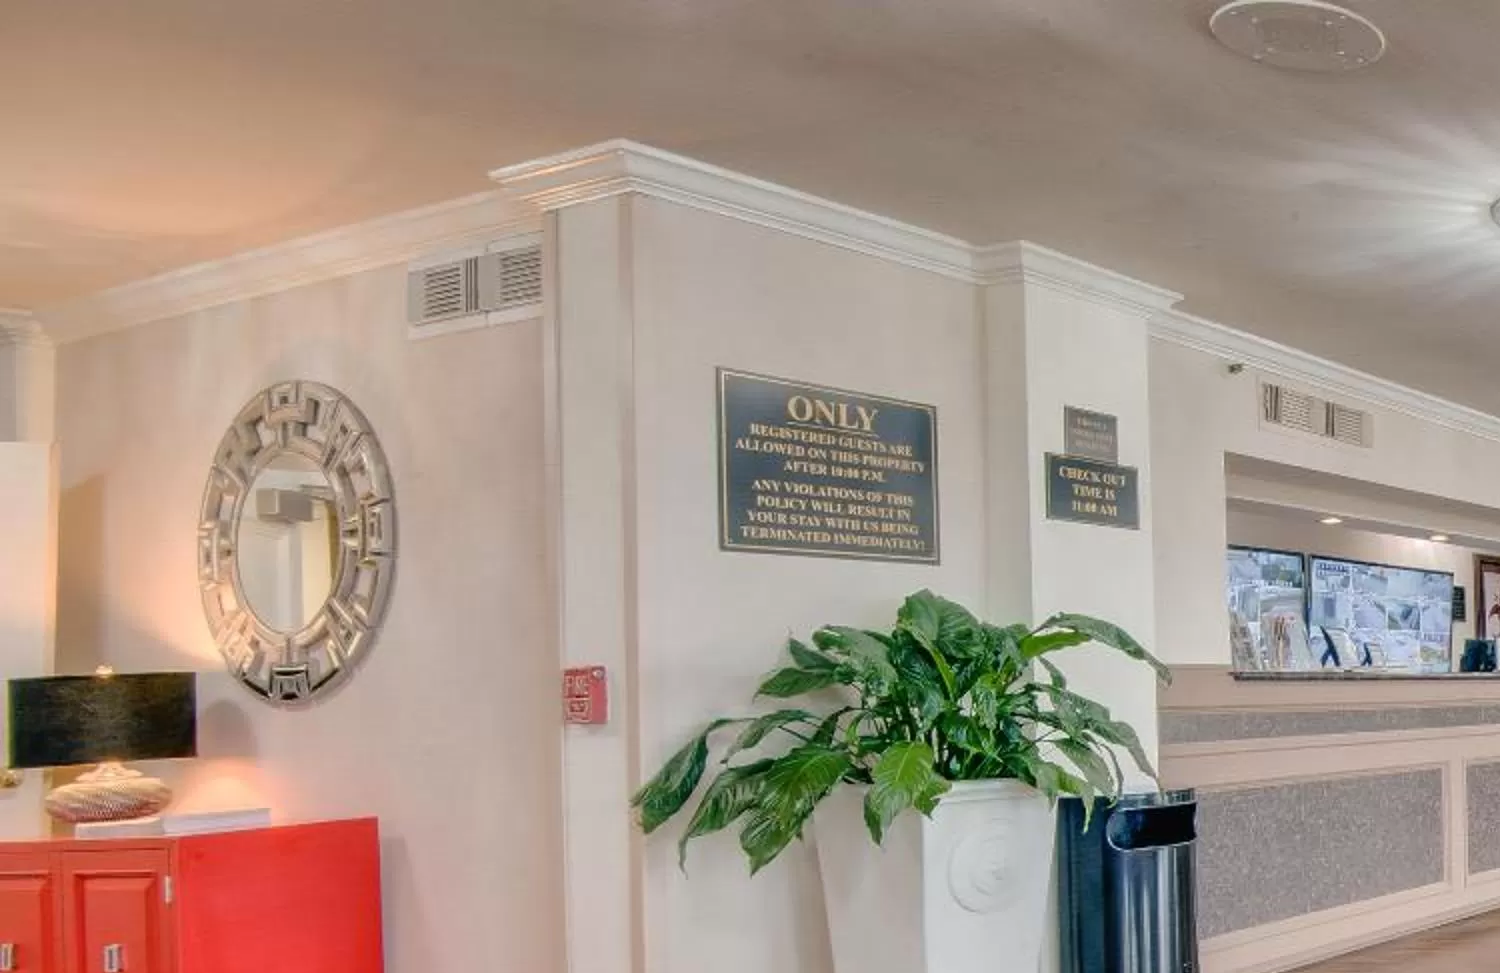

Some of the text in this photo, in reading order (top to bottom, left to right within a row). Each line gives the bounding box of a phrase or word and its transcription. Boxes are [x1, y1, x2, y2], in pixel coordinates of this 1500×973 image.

[787, 395, 880, 431] ONLY
[749, 422, 913, 458] REGISTERED GUESTS ARE
[735, 437, 925, 473] ALLOWED ON THIS PROPERTY
[783, 460, 828, 475] AFTER
[1058, 465, 1126, 488] CHECK OUT
[751, 479, 914, 507] ANY VIOLATIONS OF THIS
[1072, 483, 1116, 501] TIME IS
[746, 509, 919, 537] YOUR STAY WITH US BEING
[757, 495, 911, 523] POLICY WILL RESULT IN
[740, 525, 832, 544] TERMINATED
[564, 674, 589, 698] FIRE
